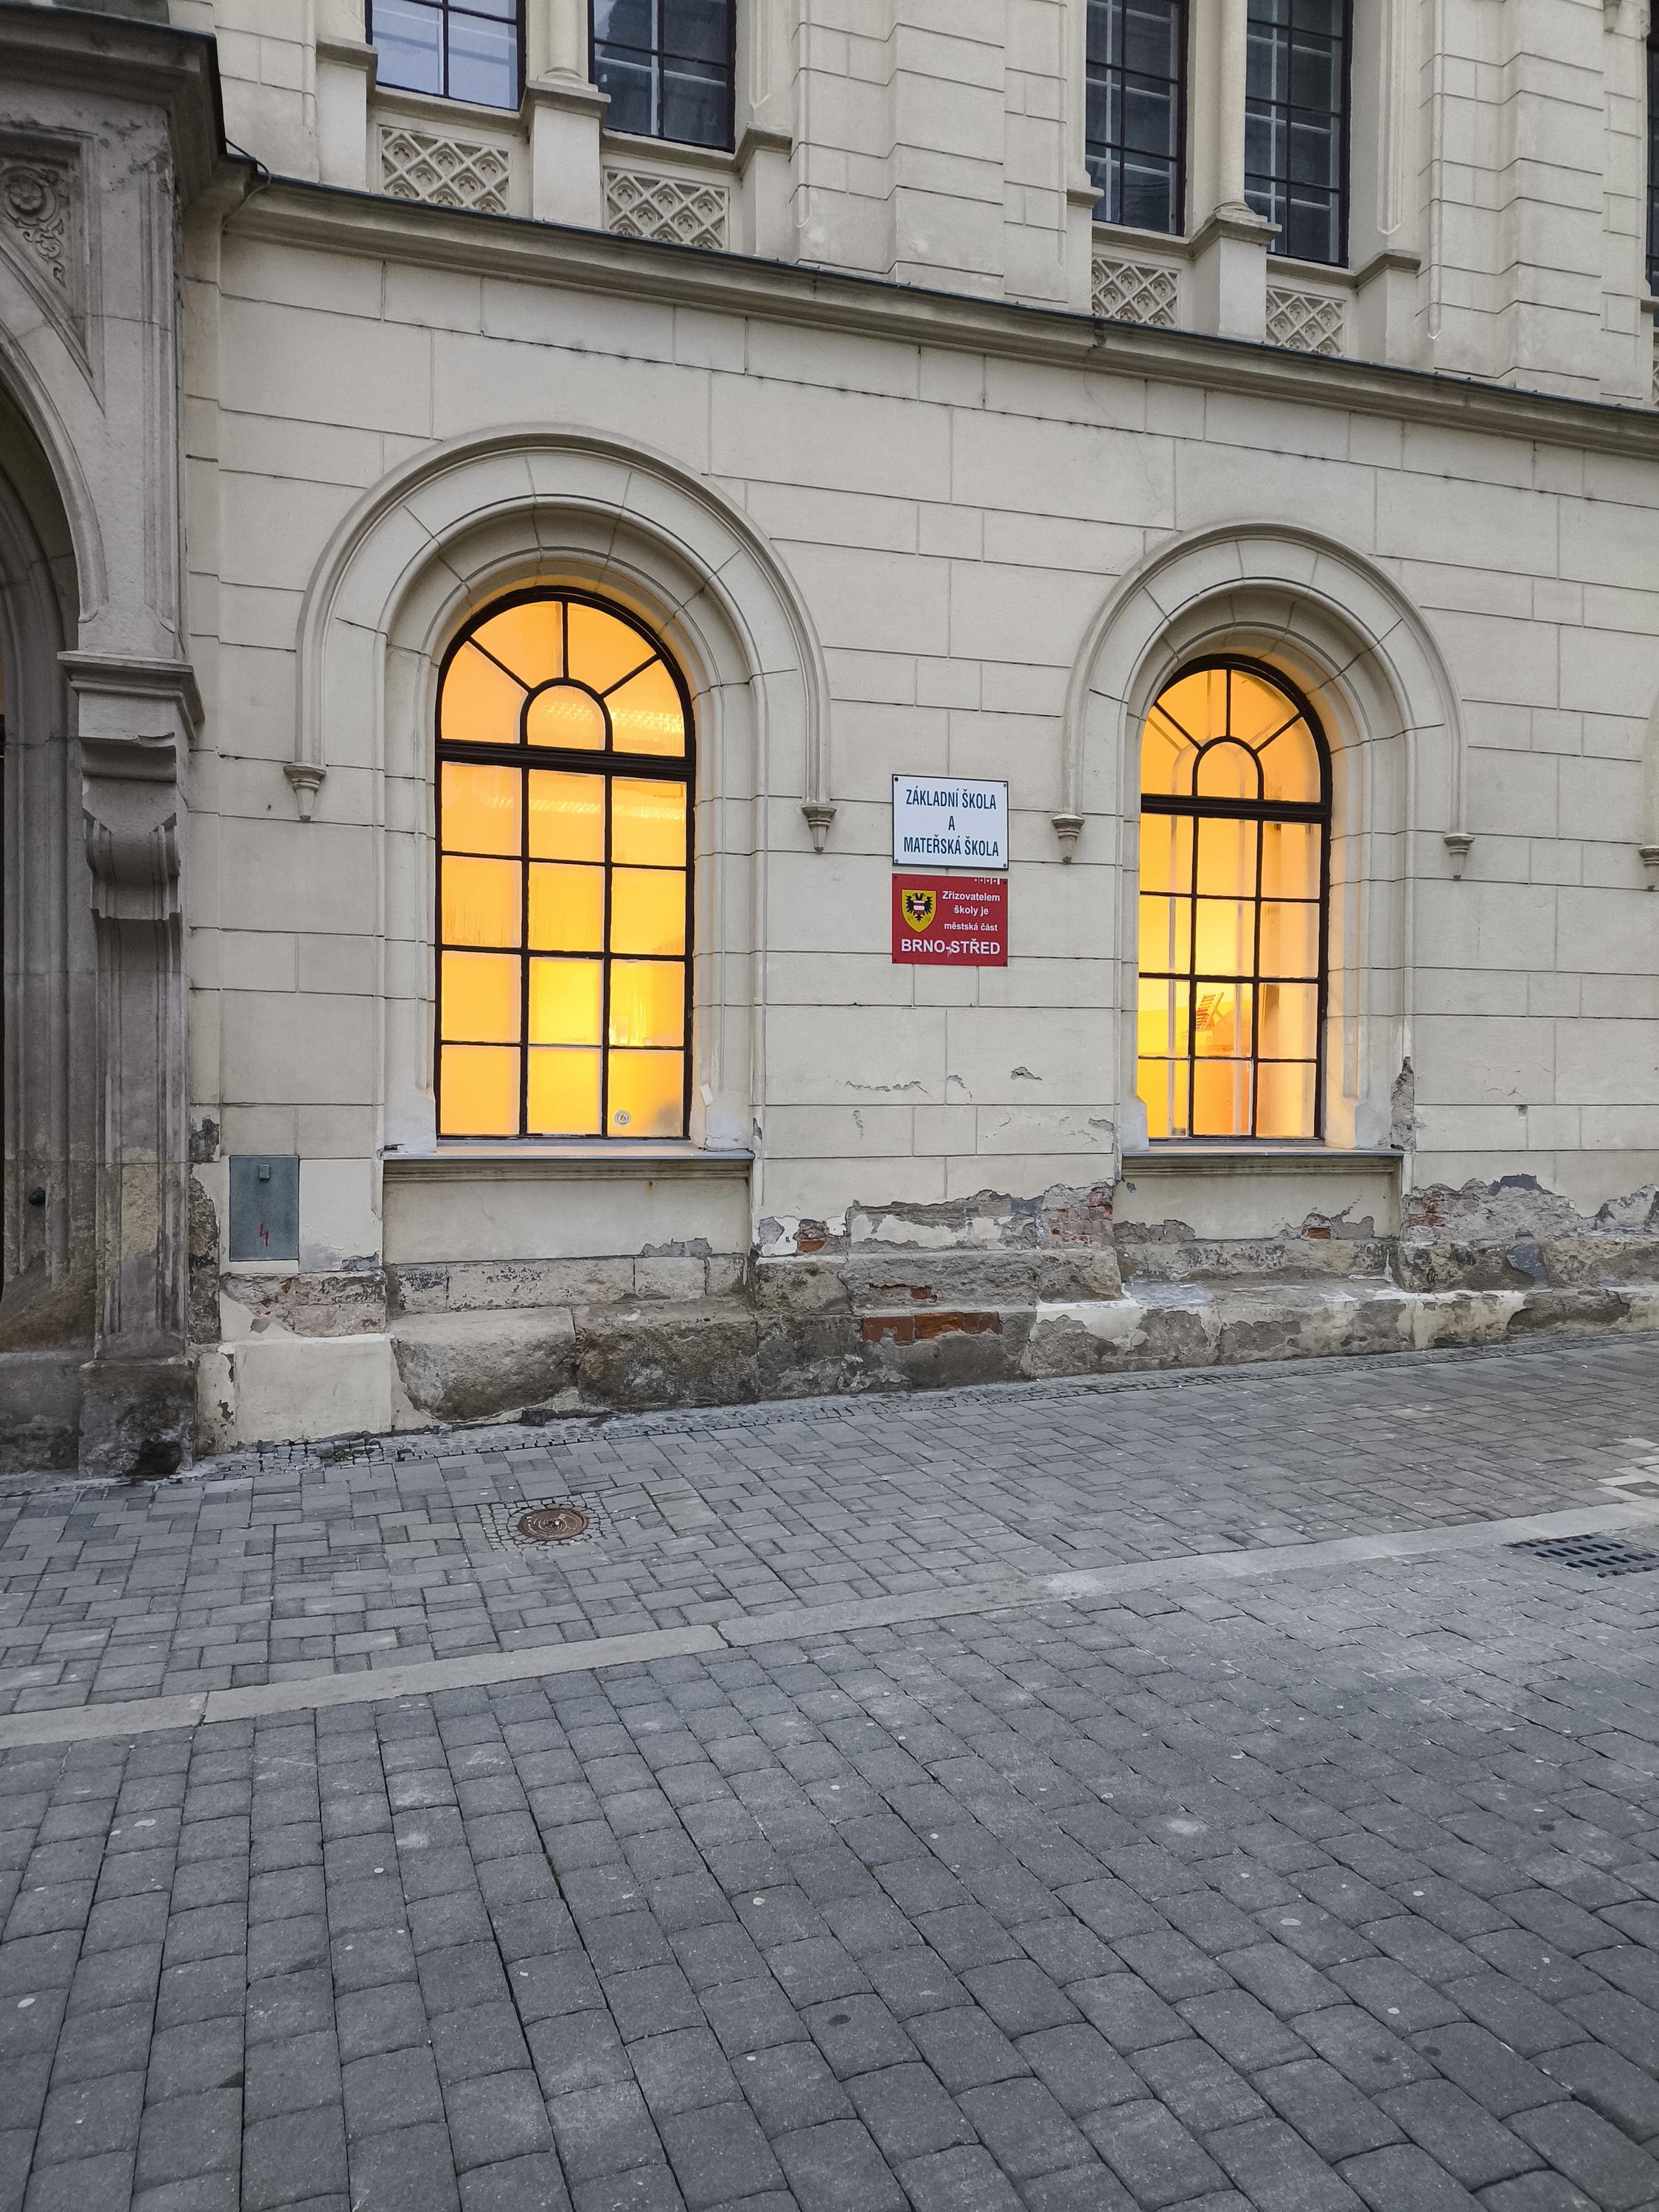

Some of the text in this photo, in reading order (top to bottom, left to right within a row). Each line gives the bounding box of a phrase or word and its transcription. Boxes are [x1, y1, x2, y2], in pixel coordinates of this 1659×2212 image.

[905, 785, 997, 810] ZÁKLADNÍ ŠKOLA
[948, 815, 955, 831] A
[903, 834, 999, 856] MATEŘSKÁ ŠKOLA
[942, 891, 1000, 902] Zřizovatelem
[954, 905, 989, 917] školy je
[944, 922, 998, 931] městská část
[901, 938, 1001, 955] BRNO-STŘED
